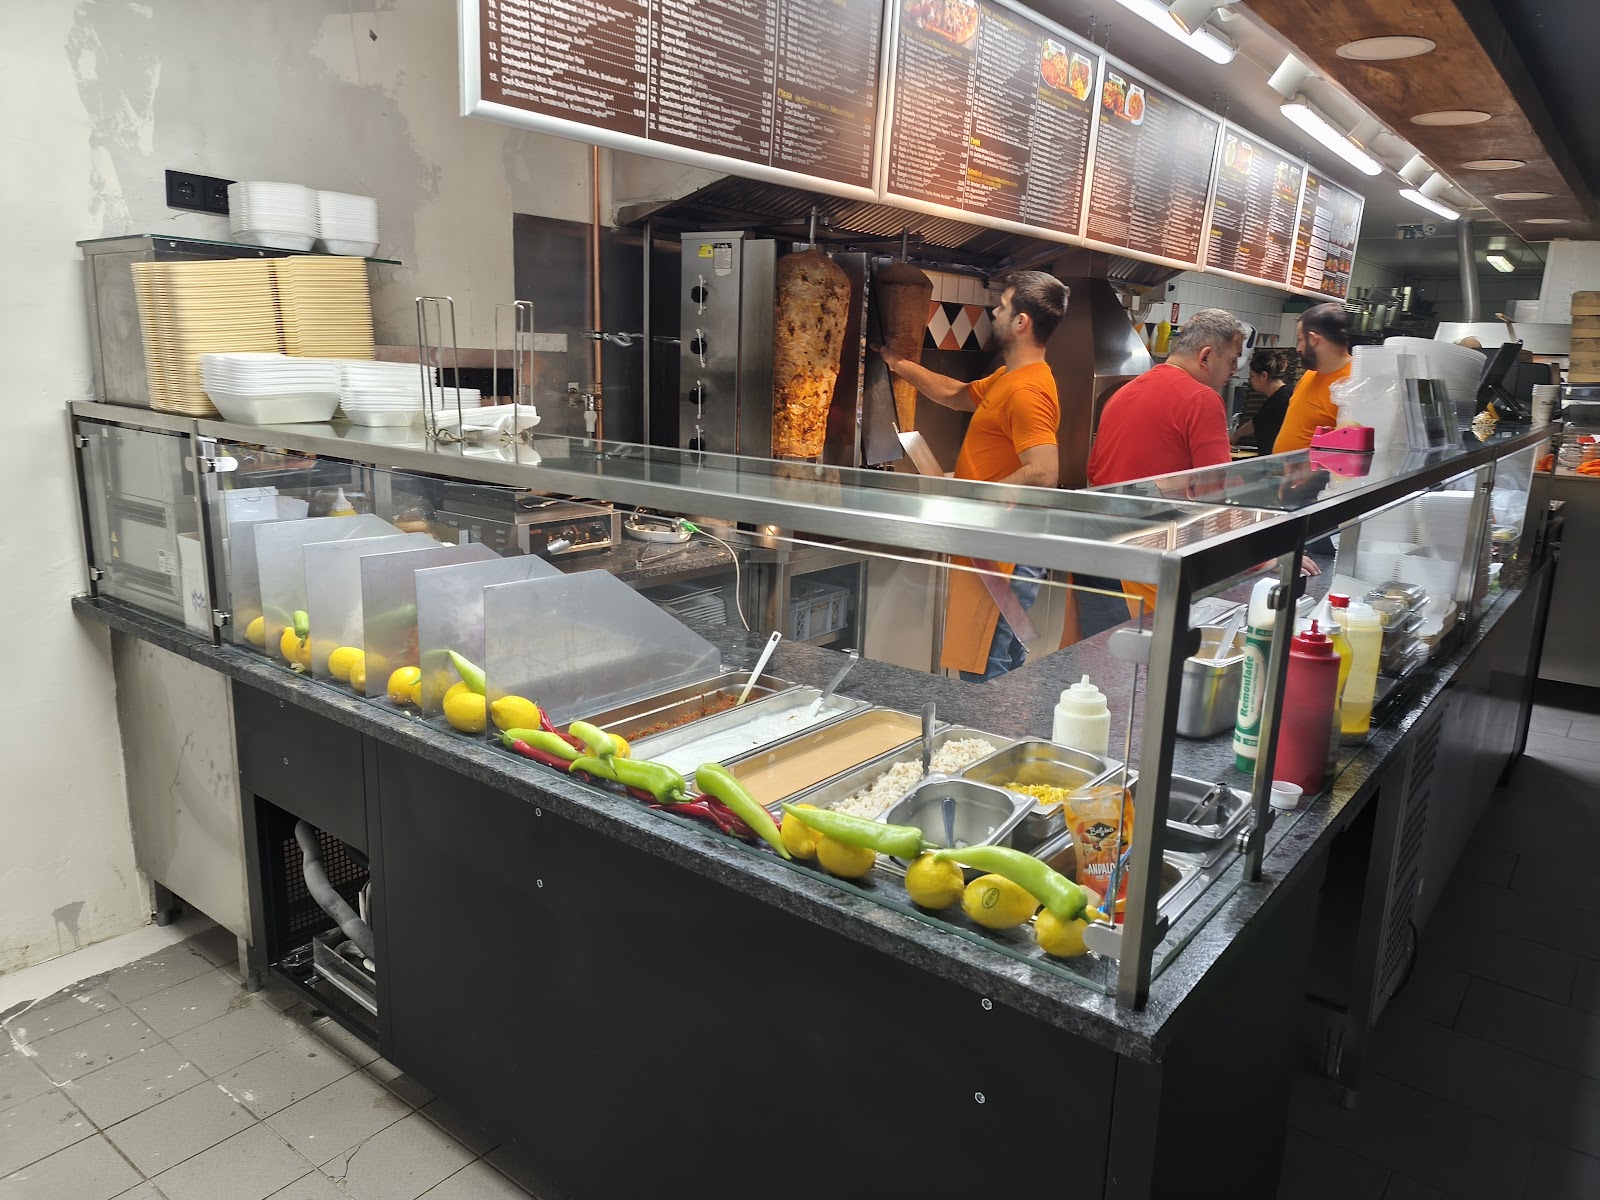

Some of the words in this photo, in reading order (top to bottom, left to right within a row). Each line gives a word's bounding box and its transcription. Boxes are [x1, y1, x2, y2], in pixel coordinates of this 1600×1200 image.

[488, 41, 498, 51] 13.
[488, 21, 497, 31] 12.
[634, 62, 646, 72] 12,00
[634, 43, 647, 54] 12,00
[634, 53, 646, 63] 12,00
[633, 90, 646, 100] 17,00
[777, 87, 792, 99] Pizza
[1240, 656, 1253, 717] Remoulade
